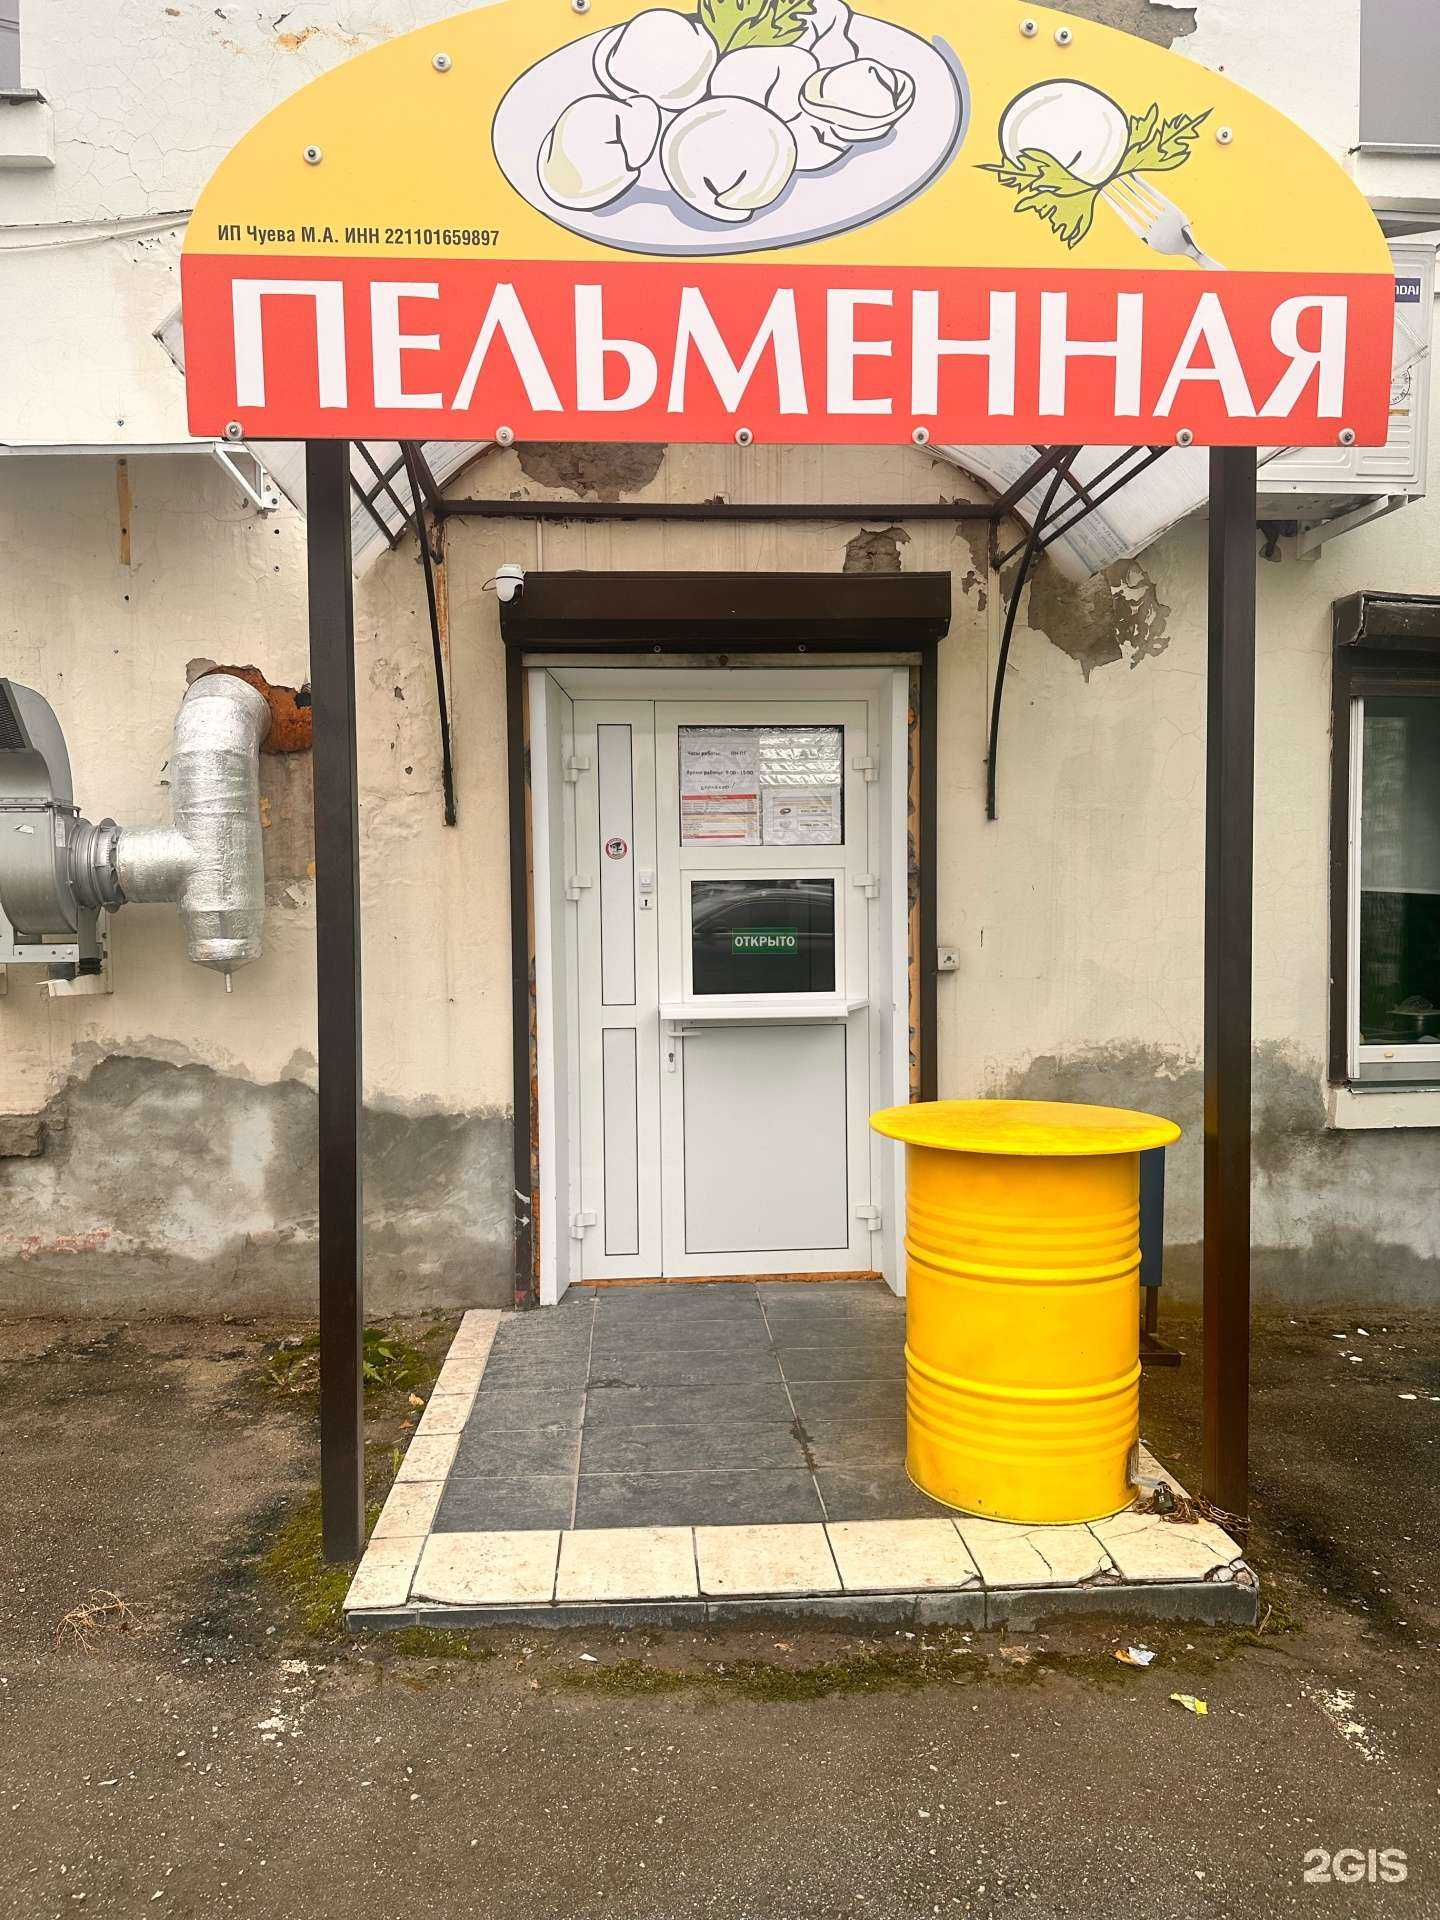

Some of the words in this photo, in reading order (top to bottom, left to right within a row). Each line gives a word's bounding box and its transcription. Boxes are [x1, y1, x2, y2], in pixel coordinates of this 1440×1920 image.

[217, 224, 241, 241] ИП
[246, 225, 296, 245] Чуева
[301, 226, 339, 243] М.А.
[345, 227, 380, 244] ИНН
[385, 228, 500, 246] 221101659897
[231, 278, 1348, 419] ПЕЛЬМЕННАЯ
[734, 935, 796, 948] ОТКРЫТО
